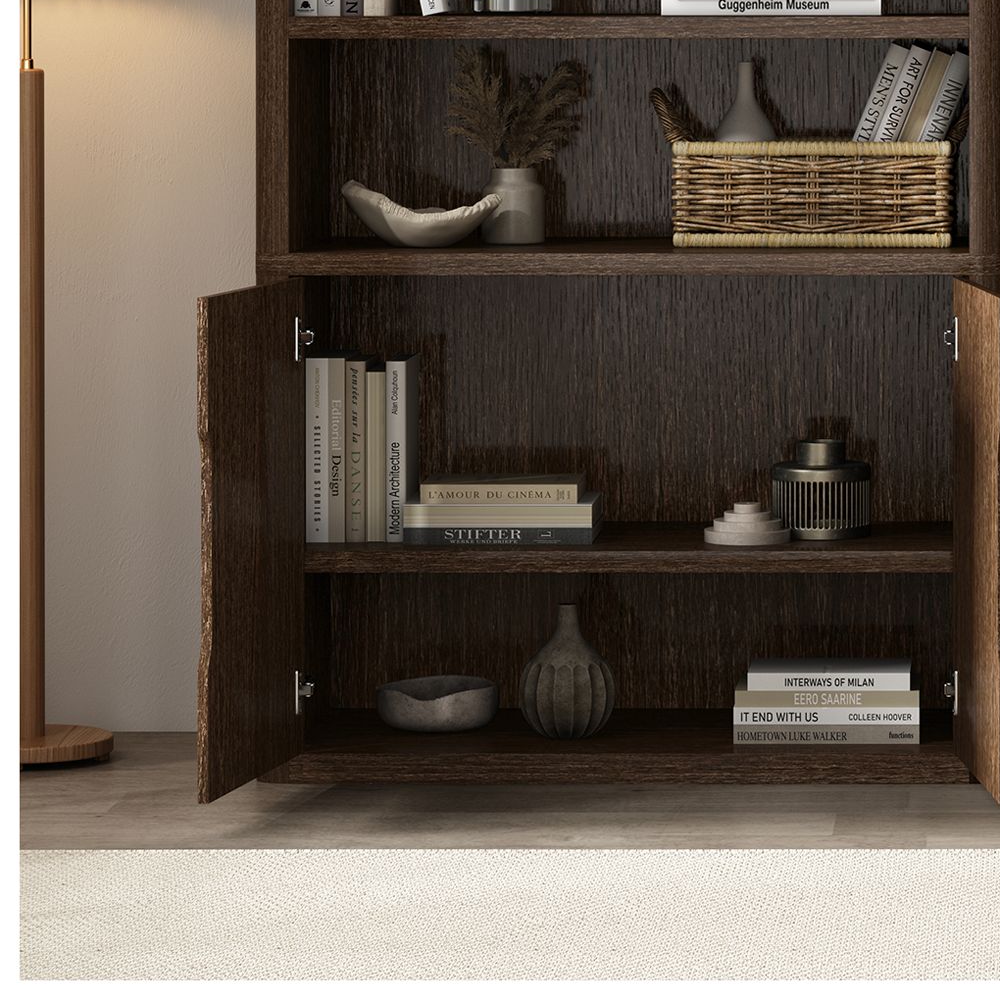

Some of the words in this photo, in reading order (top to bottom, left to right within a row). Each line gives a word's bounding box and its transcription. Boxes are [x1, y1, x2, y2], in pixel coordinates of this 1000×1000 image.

[786, 0, 830, 10] Museum
[906, 56, 923, 80] ART
[871, 63, 899, 108] MEN'S
[895, 80, 914, 105] FOR
[856, 107, 880, 142] STYL
[879, 105, 904, 143] SURVIV
[390, 369, 398, 401] Colquhoun
[331, 399, 342, 451] Editorial
[313, 425, 321, 474] SELECTED
[351, 432, 361, 444] la
[329, 454, 342, 497] Design
[389, 442, 400, 498] Architecture
[313, 480, 321, 523] STORIES
[428, 490, 480, 499] L'AMOUR
[486, 490, 503, 499] DU
[507, 488, 552, 499] CINÉMA
[389, 499, 400, 535] Modern
[444, 529, 522, 540] STIFTER
[784, 677, 832, 687] INTERWAYS
[834, 677, 846, 687] OF
[847, 677, 875, 687] MILAN
[794, 693, 818, 705] EERO
[820, 693, 862, 705] SAARINE
[740, 712, 750, 722] IT
[752, 712, 774, 722] END
[776, 712, 802, 722] WITH
[804, 712, 819, 722] US
[848, 713, 881, 721] COLLEEN
[882, 713, 912, 721] HOOVER
[737, 731, 787, 741] HOMETOWN
[788, 731, 811, 741] LUKE
[812, 731, 848, 741] WALKER
[888, 732, 914, 740] functions
